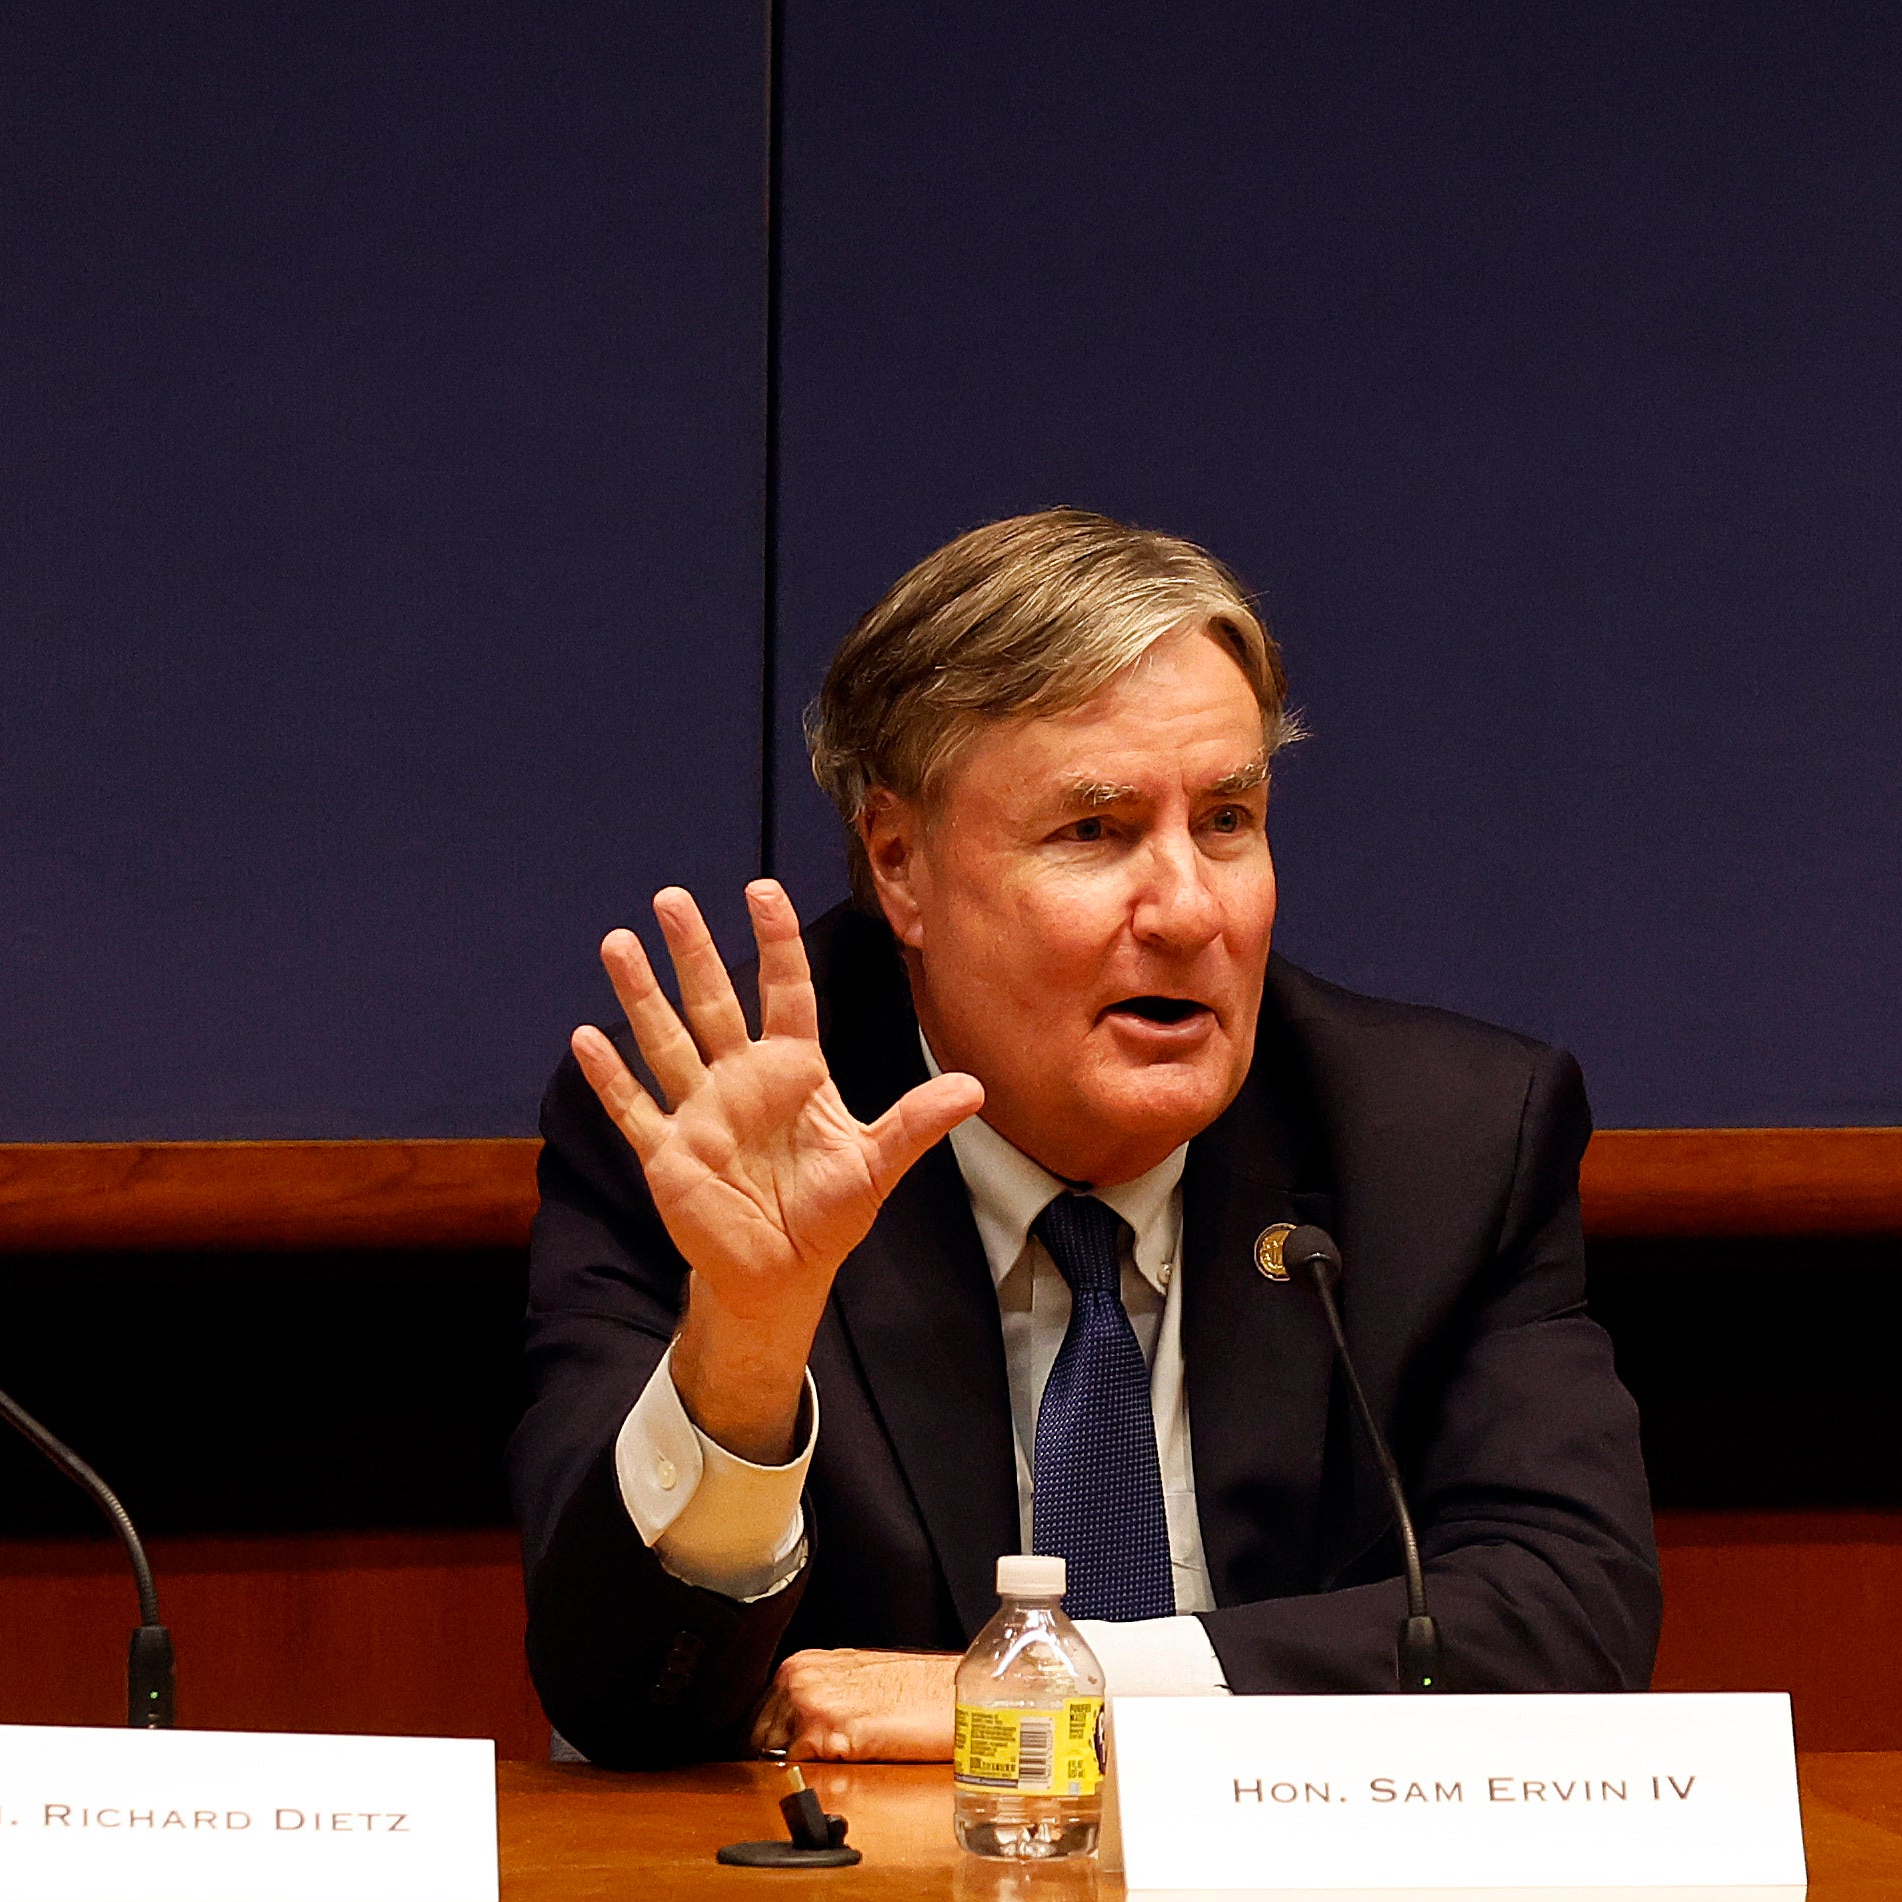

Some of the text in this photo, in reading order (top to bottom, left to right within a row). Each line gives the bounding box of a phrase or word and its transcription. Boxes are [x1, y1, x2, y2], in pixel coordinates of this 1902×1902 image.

[1231, 1774, 1697, 1805] HON. SAM ERVIN IV
[42, 1802, 252, 1831] RICHARD
[273, 1807, 411, 1833] DIETZ
